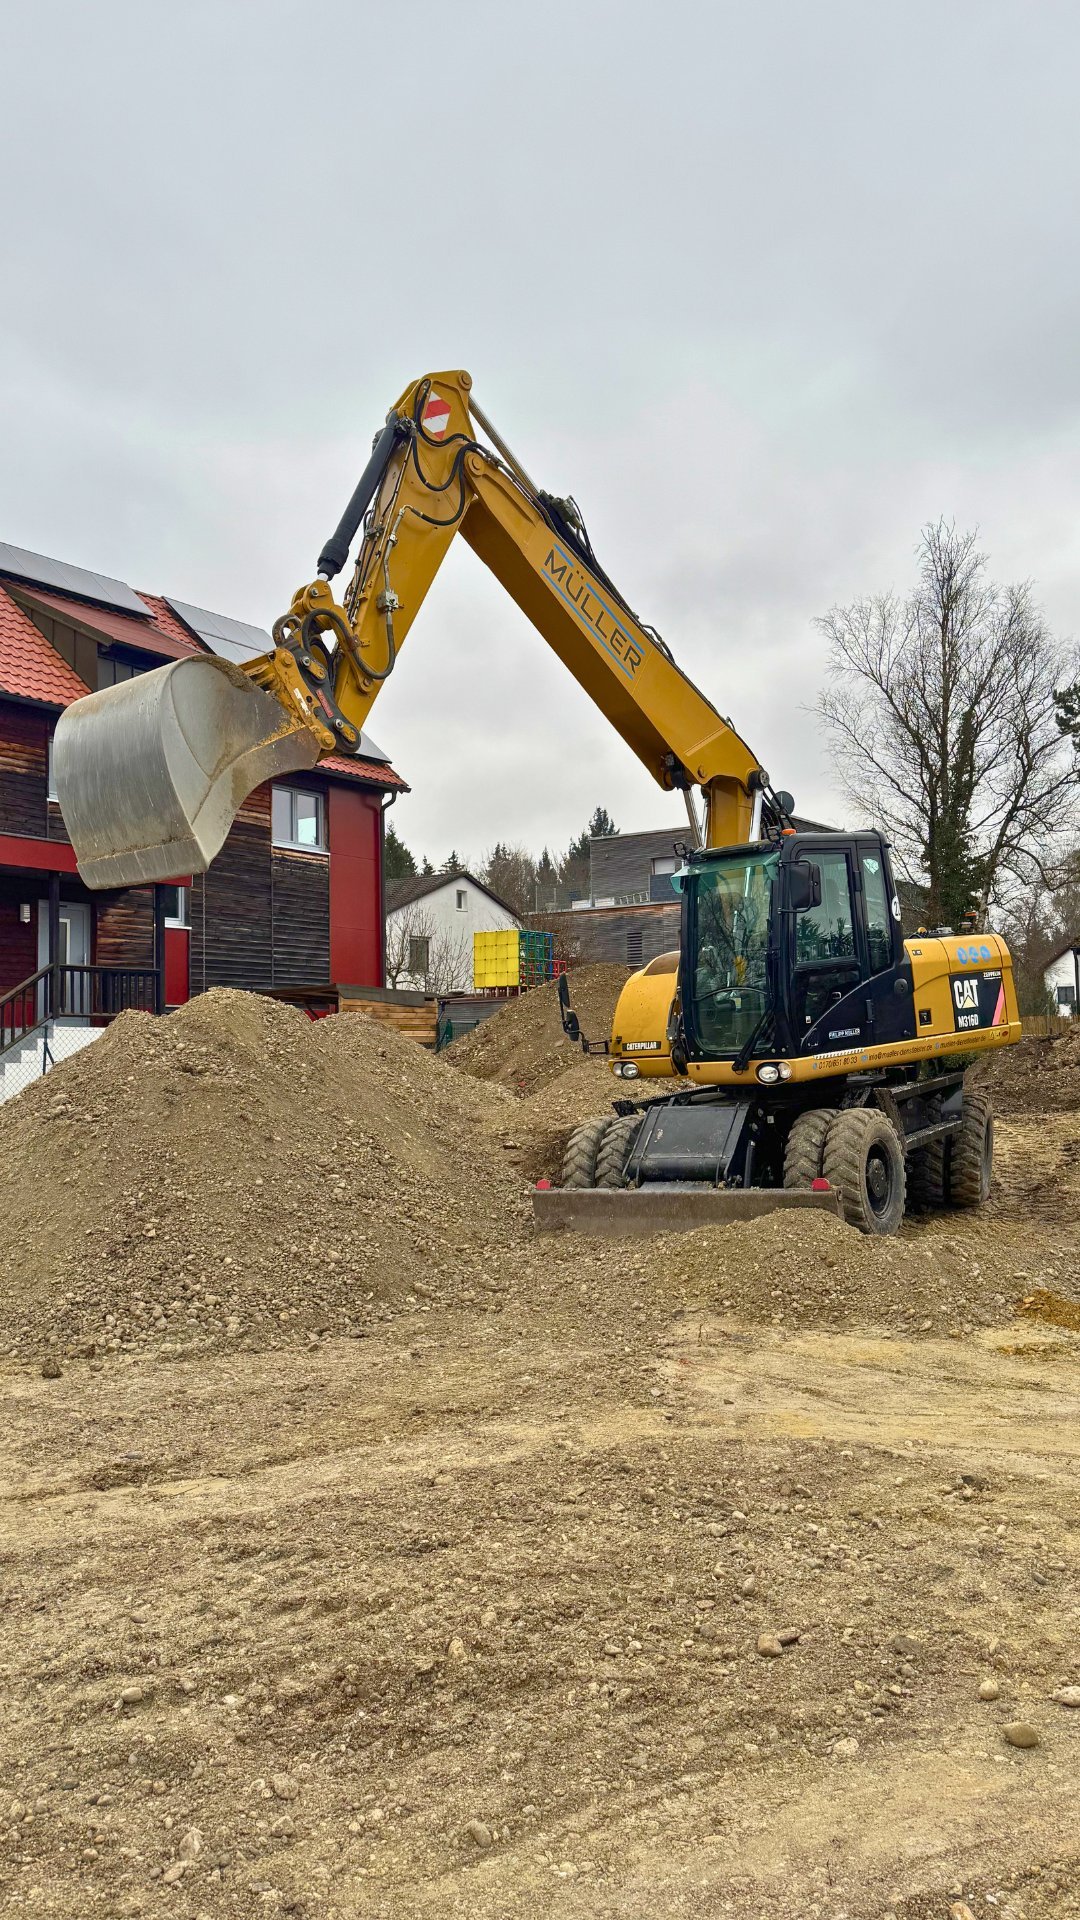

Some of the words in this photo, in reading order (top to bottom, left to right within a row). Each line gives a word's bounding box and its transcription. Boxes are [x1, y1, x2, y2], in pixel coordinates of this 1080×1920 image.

[543, 549, 642, 674] MÜLLER
[953, 979, 979, 1009] CAT
[957, 1013, 979, 1028] M316D
[626, 1041, 657, 1051] CATERPILLAR
